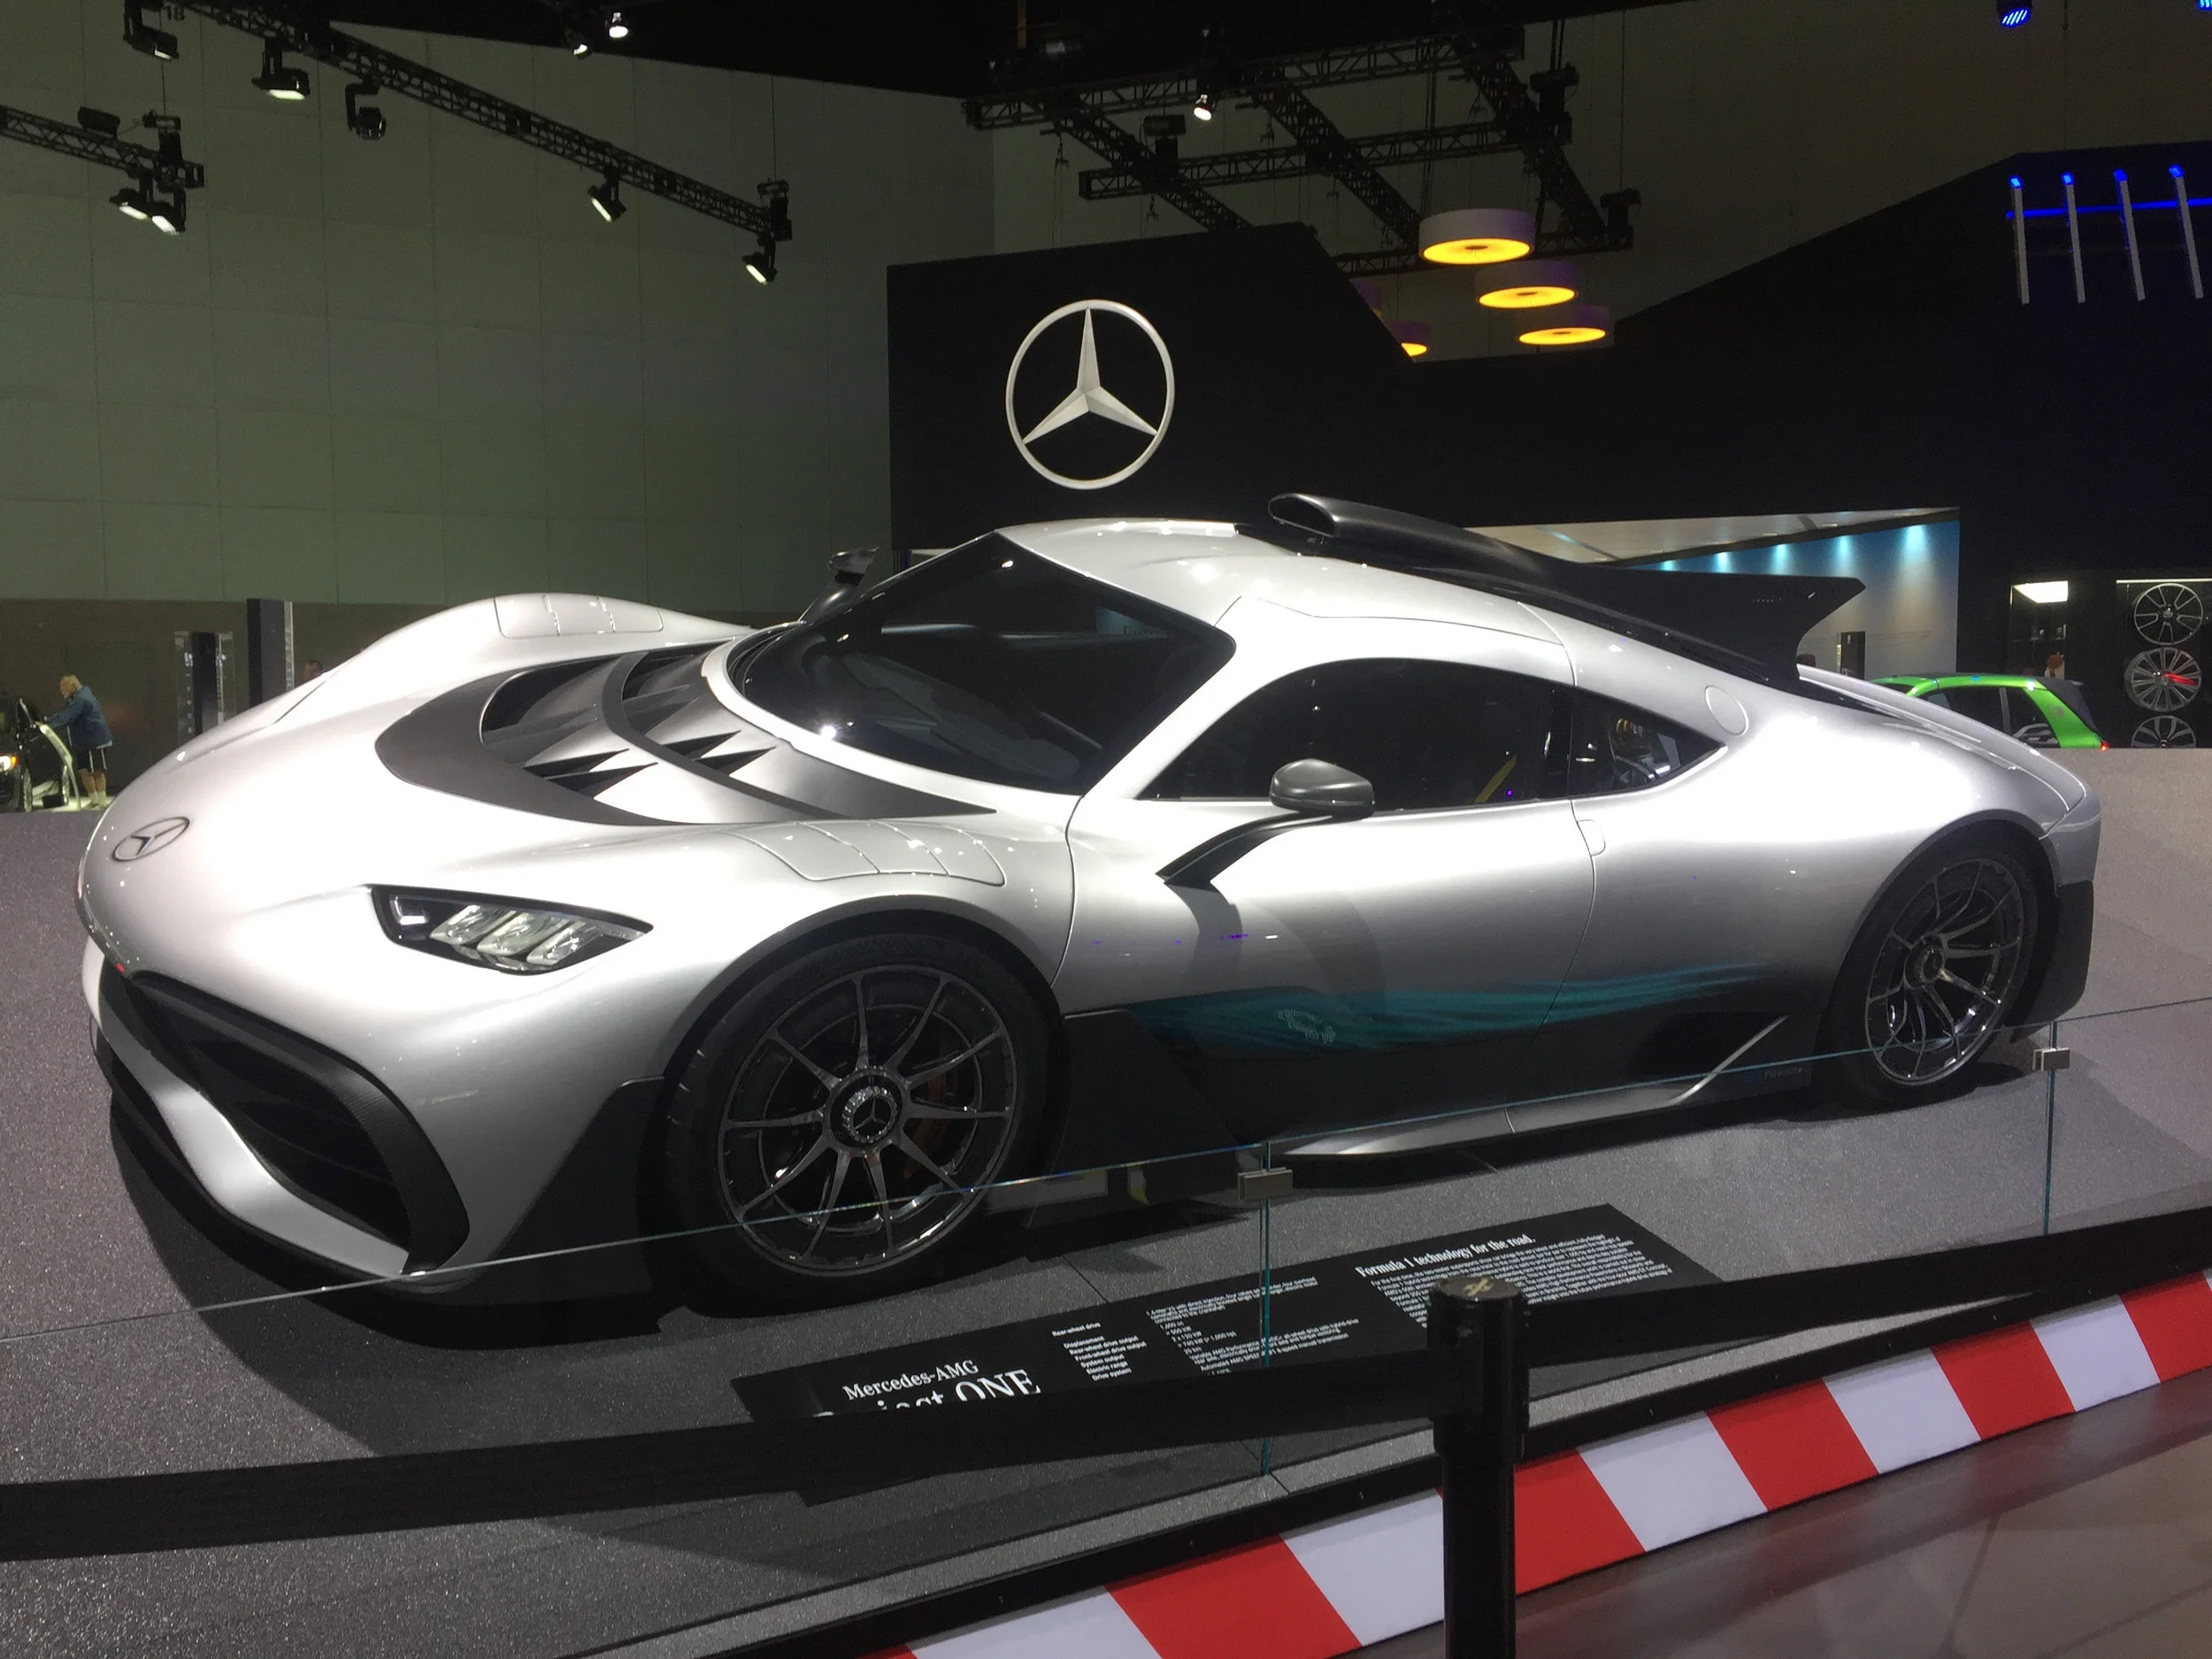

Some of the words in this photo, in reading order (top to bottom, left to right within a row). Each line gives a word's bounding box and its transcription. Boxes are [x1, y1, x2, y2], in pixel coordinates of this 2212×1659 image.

[1356, 1260, 1405, 1278] Formula
[1403, 1257, 1415, 1268] 1
[1413, 1246, 1473, 1266] technology
[1469, 1242, 1489, 1254] for
[1488, 1239, 1508, 1252] the
[1507, 1234, 1536, 1248] road.
[842, 1359, 979, 1401] Mercedes-AMG
[955, 1368, 1041, 1403] ONE
